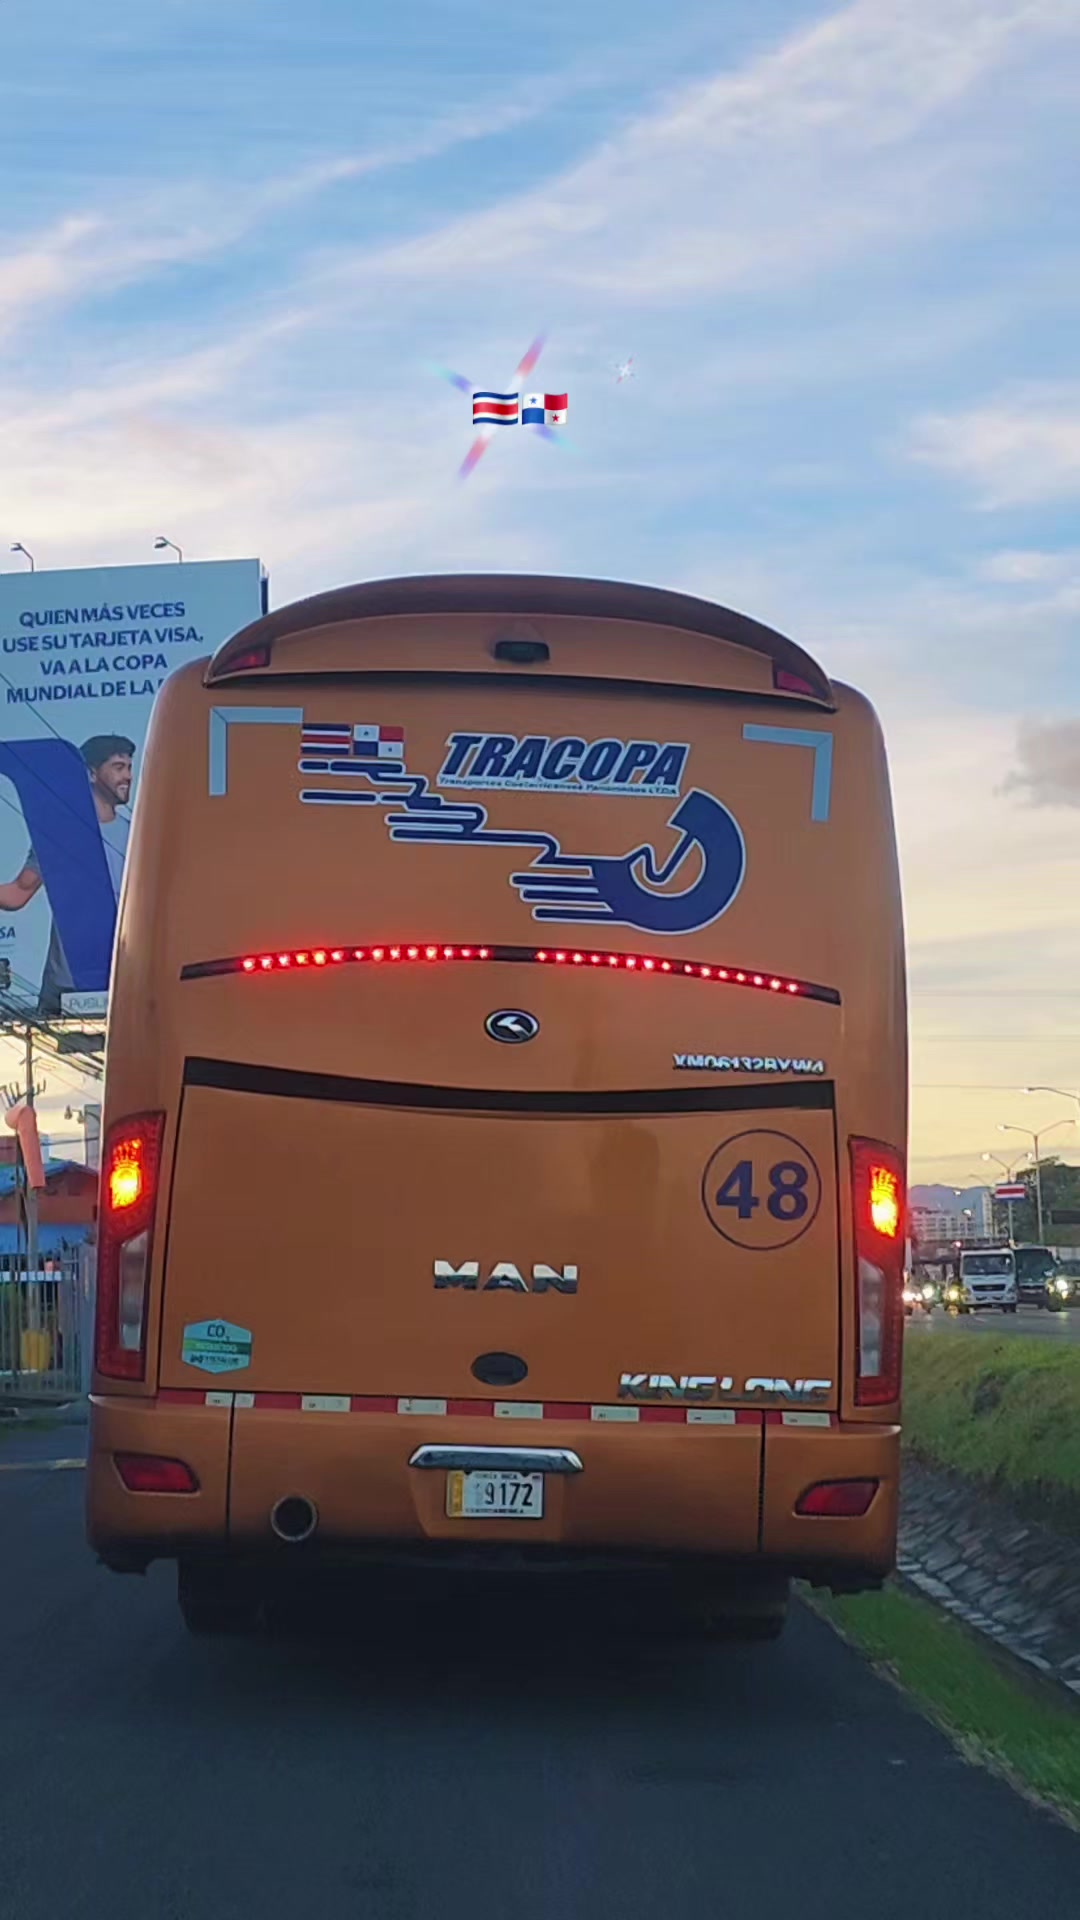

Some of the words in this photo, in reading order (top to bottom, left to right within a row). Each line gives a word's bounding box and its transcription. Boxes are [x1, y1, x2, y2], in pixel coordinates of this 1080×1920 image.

[19, 608, 79, 629] QUIEN
[81, 602, 124, 623] MÁS
[126, 601, 186, 620] VECES
[2, 636, 40, 653] USE
[42, 633, 67, 651] SU
[69, 629, 152, 649] TARJETA
[40, 659, 66, 676] VA
[68, 659, 82, 674] A
[85, 656, 110, 673] LA
[112, 653, 168, 671] COPA
[7, 683, 98, 704] MUNDIAL
[101, 681, 126, 697] DE
[129, 679, 155, 696] LA
[441, 734, 690, 786] TRACOPA
[715, 1160, 809, 1221] 48
[433, 1259, 579, 1295] MAN
